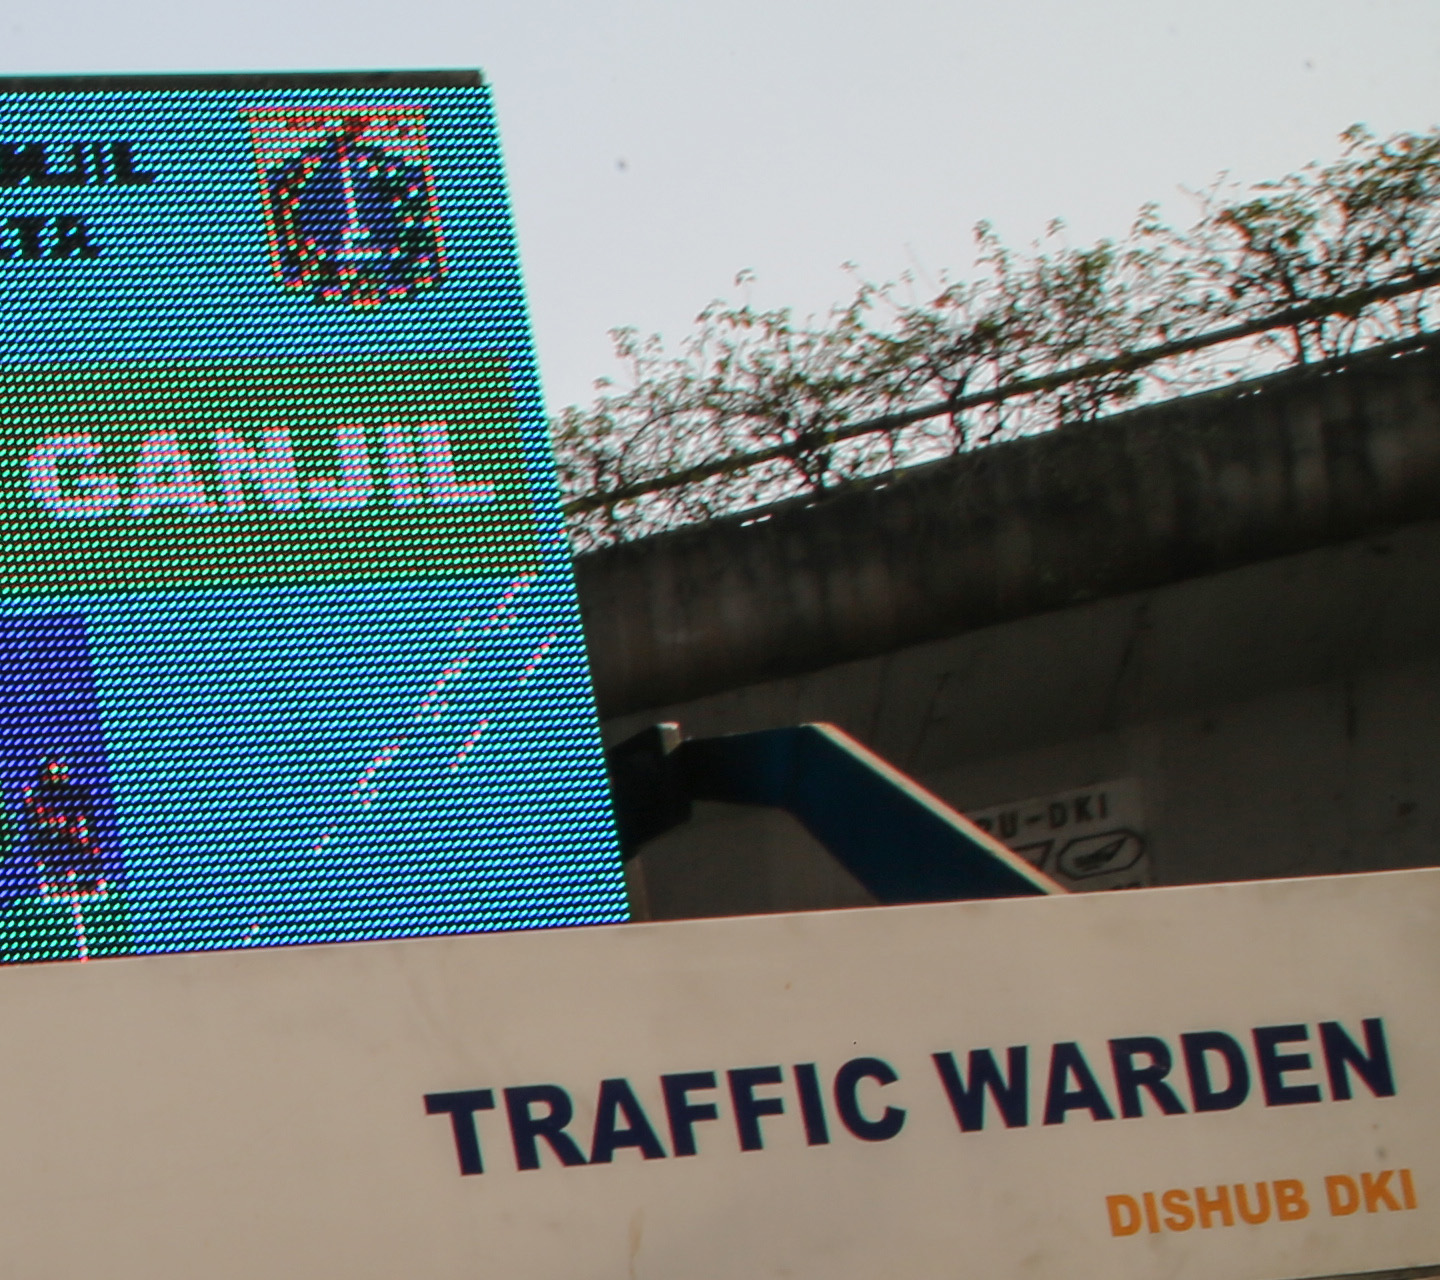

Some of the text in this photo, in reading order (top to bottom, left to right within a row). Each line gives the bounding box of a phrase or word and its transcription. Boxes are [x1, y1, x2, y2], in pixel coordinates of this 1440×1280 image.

[26, 421, 497, 523] GANJIL
[423, 1015, 1397, 1178] TRAFFIC WARDEN
[1104, 1166, 1418, 1239] DISHUB DKI
